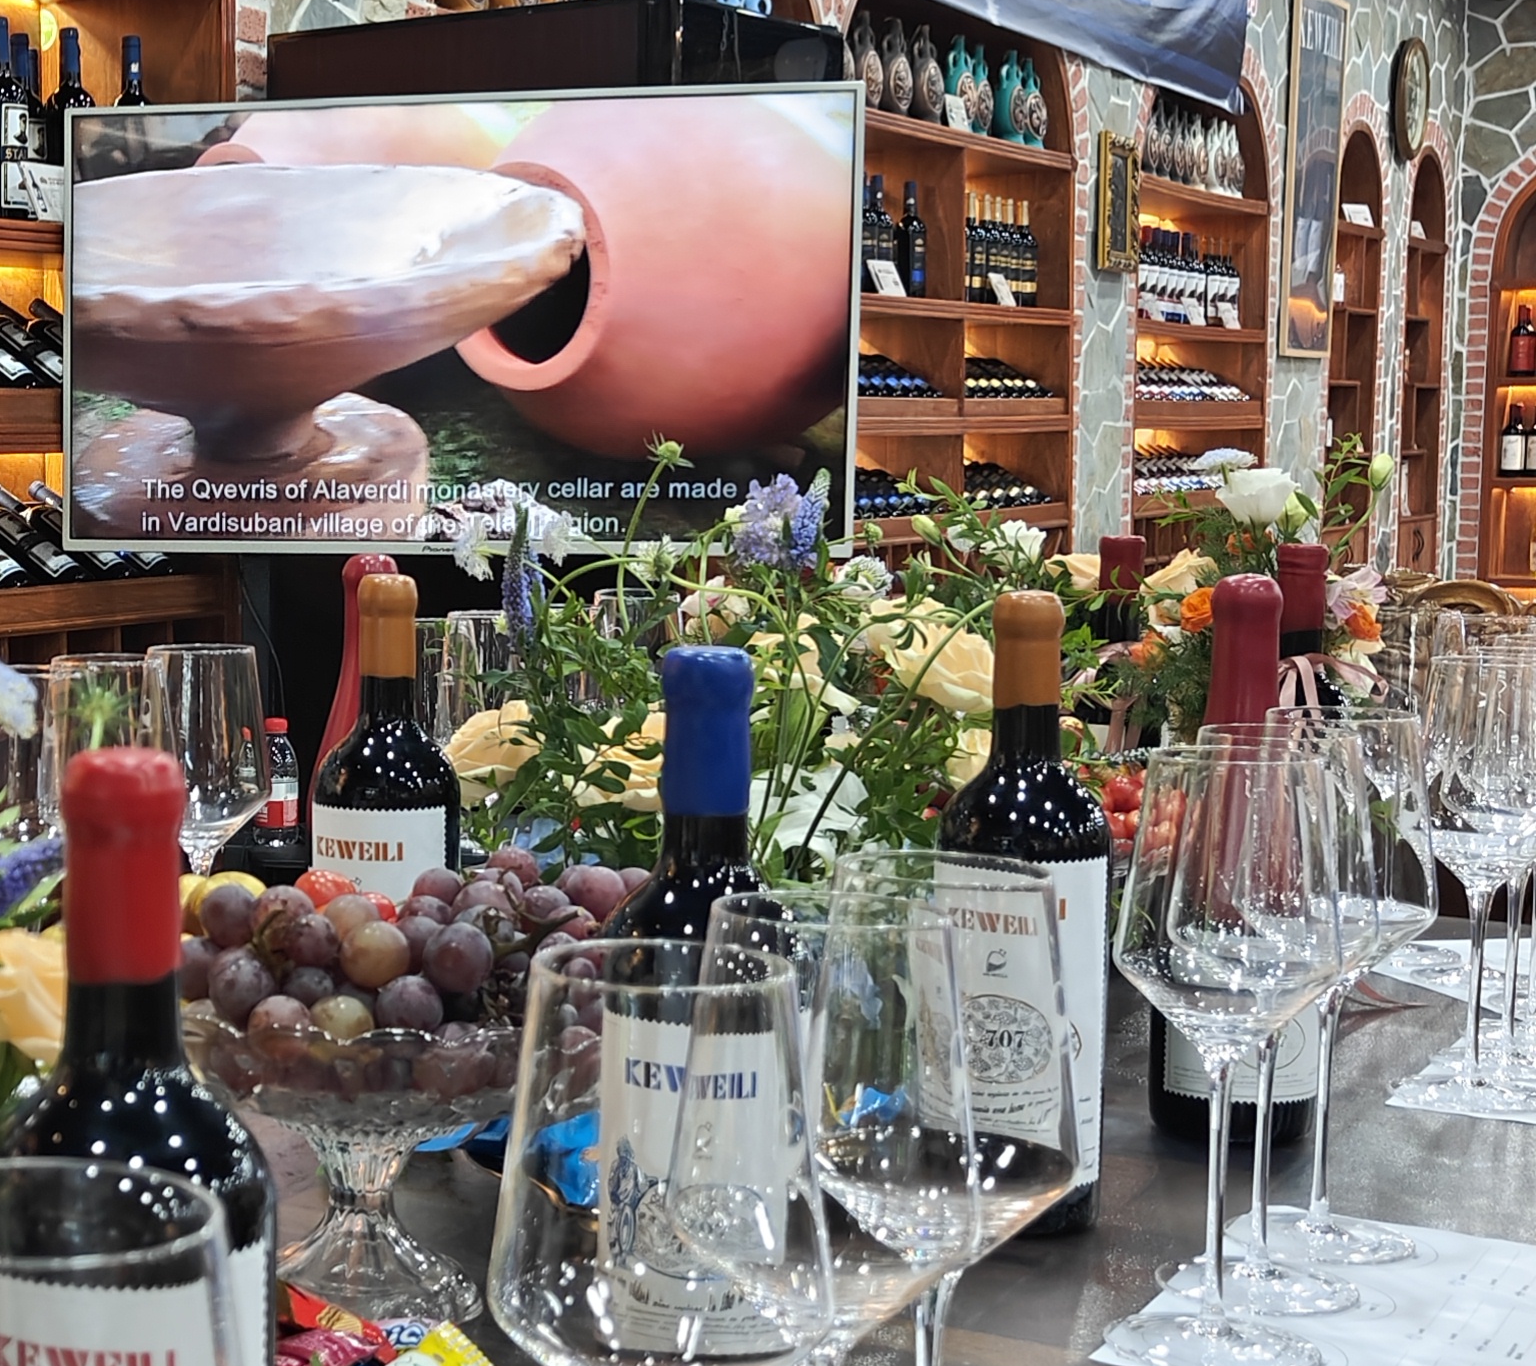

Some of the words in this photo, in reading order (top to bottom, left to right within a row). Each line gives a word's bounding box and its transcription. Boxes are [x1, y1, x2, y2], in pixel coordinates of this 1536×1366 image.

[141, 478, 184, 500] The
[191, 477, 277, 501] Qvevris
[284, 477, 308, 500] of
[312, 477, 408, 500] Alaverdi
[416, 479, 540, 504] monastery
[547, 478, 614, 500] cellar
[620, 482, 660, 500] are
[668, 478, 738, 500] made
[141, 511, 160, 533] in
[168, 511, 302, 533] Vardisubani
[310, 510, 383, 538] village
[390, 511, 414, 533] of
[420, 511, 457, 533] the
[316, 835, 404, 861] KEWEILI
[946, 907, 1039, 936] KEWEILI
[984, 1028, 1026, 1048] 707
